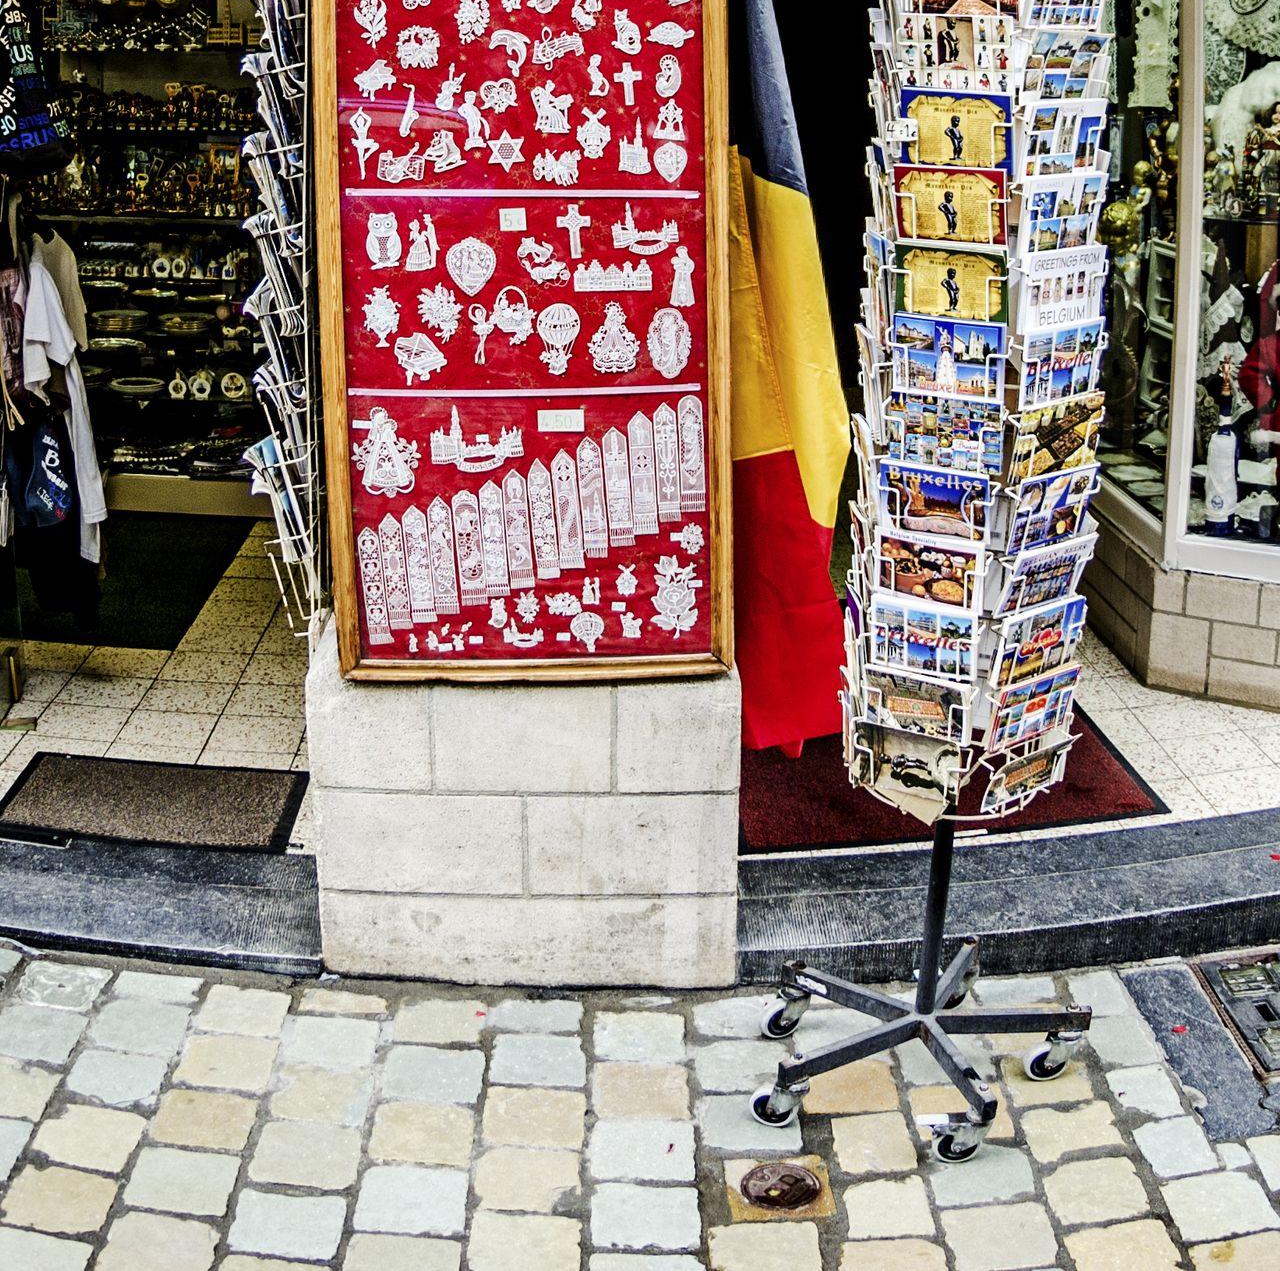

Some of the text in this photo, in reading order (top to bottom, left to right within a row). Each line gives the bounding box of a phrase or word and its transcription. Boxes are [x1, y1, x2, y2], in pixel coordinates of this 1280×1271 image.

[1034, 253, 1100, 272] GREETINGS FROM
[1039, 306, 1086, 327] BELGIUM
[888, 465, 984, 491] Bruxelles
